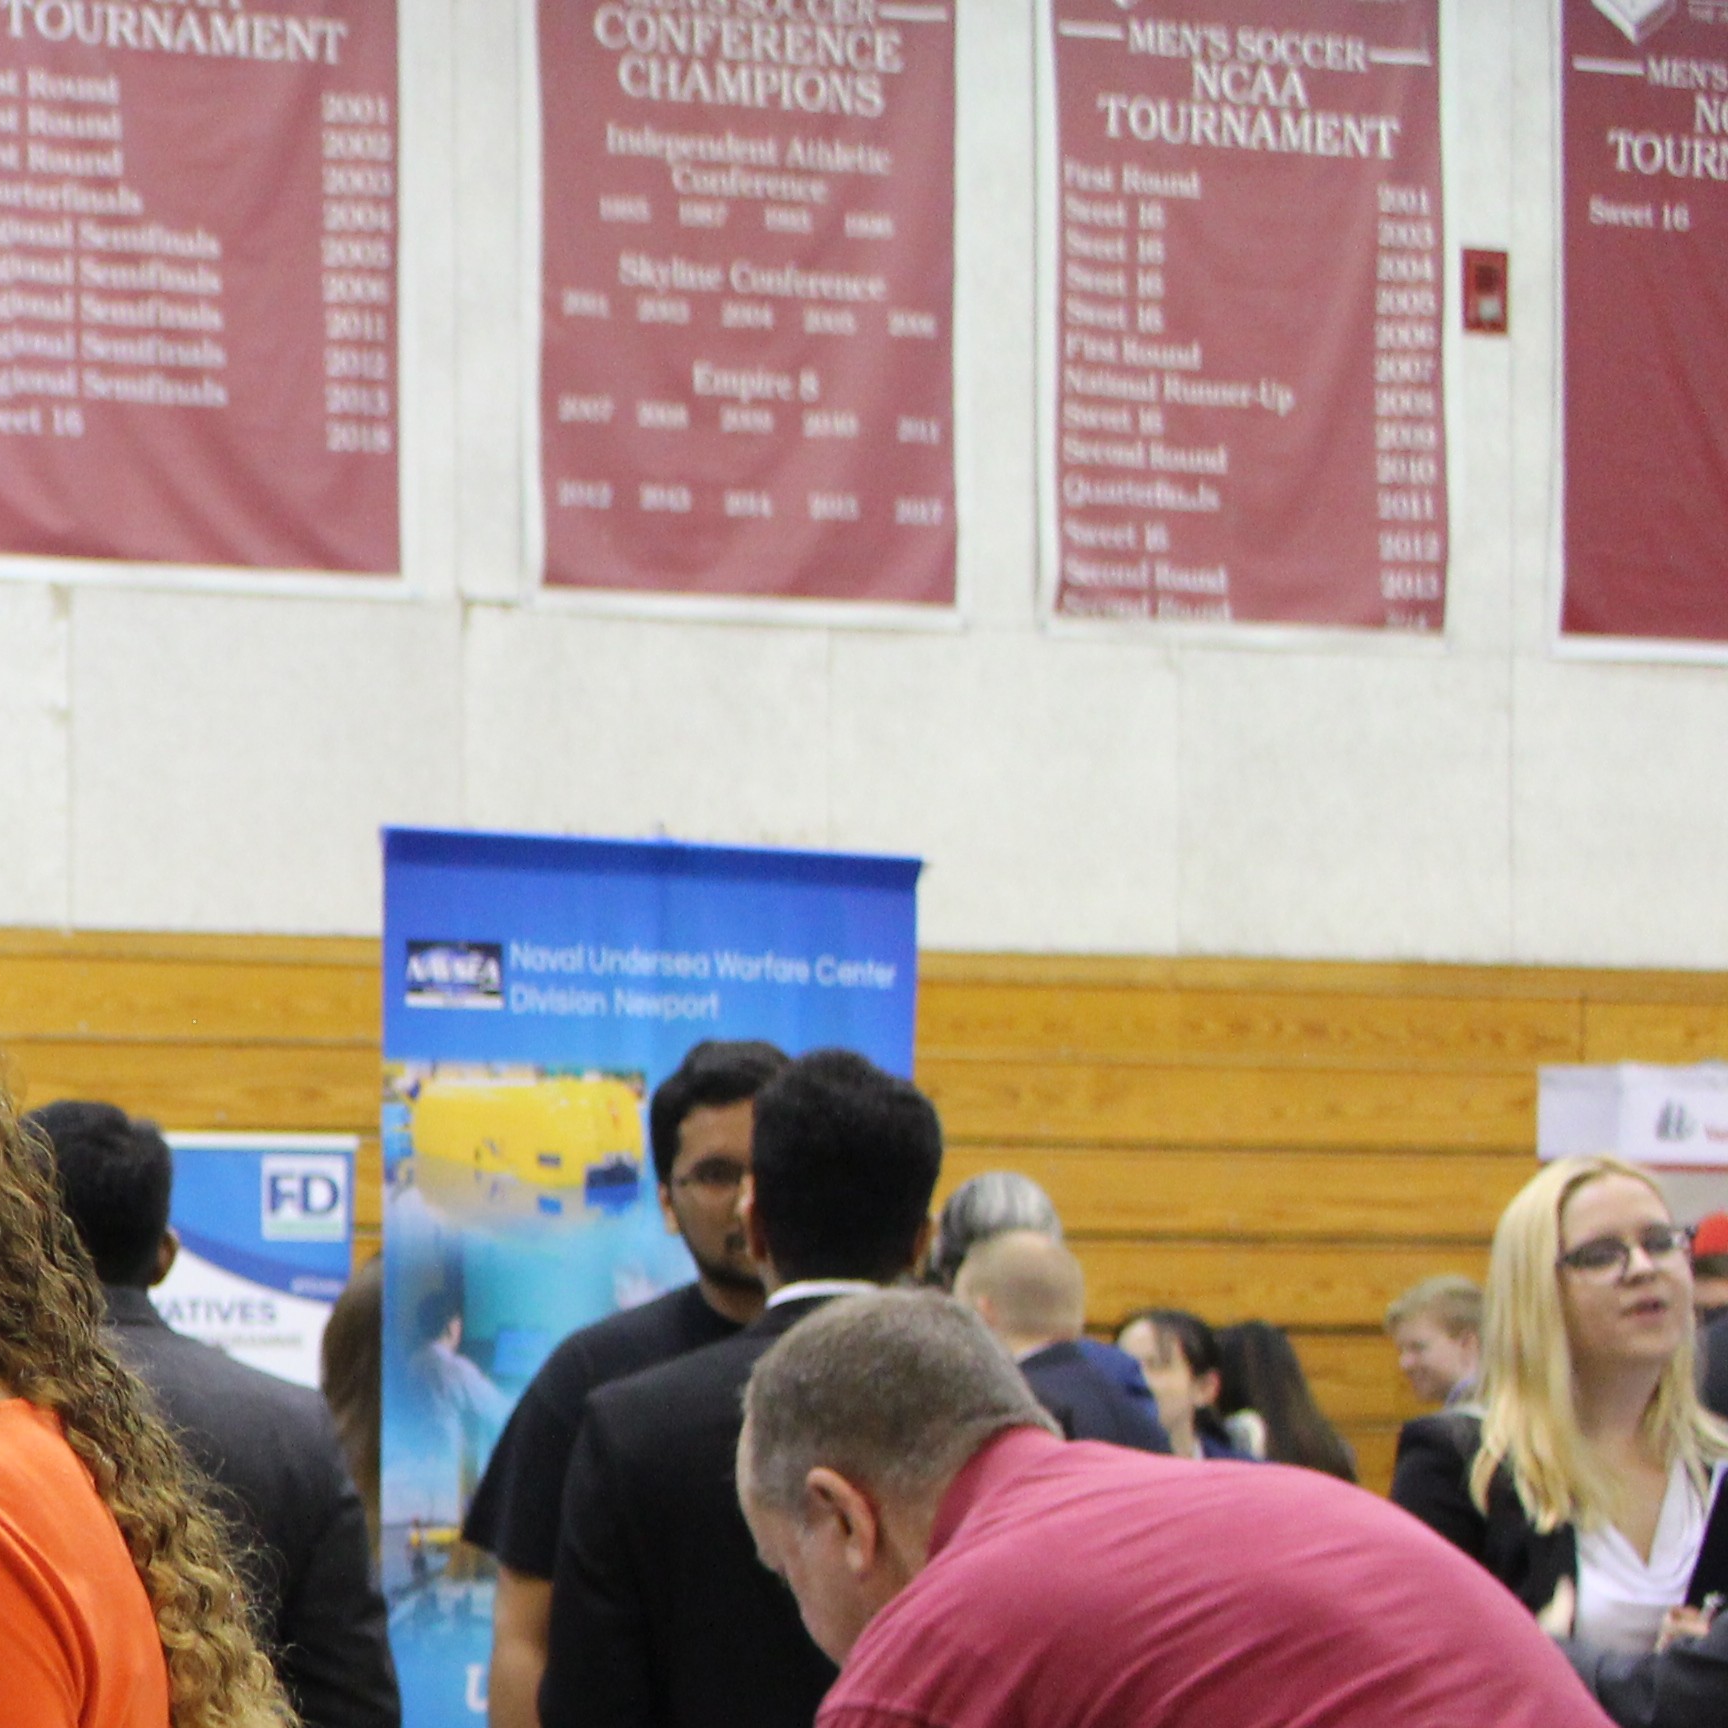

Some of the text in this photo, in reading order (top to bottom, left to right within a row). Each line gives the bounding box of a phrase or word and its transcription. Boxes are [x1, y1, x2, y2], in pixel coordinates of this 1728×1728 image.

[594, 2, 904, 74] CONFERENCE
[1128, 16, 1368, 74] MEN'S SOCCER
[28, 66, 120, 105] Round
[618, 52, 885, 118] CHAMPIONS
[1191, 59, 1309, 109] NCAA
[28, 103, 123, 140] Round
[1096, 92, 1401, 160] TOURNAMENT
[28, 140, 124, 177] Round
[606, 121, 893, 175] Independent Athletic
[672, 163, 828, 203] Conference
[1122, 163, 1201, 199] Round
[1065, 194, 1128, 230] Sweet
[1138, 200, 1166, 230] 16
[1589, 195, 1691, 233] Sweet 16
[1065, 226, 1128, 263] Sweet
[1137, 233, 1166, 265] 16
[619, 251, 887, 301] Skyline Conference
[1065, 258, 1128, 298] Sweet
[1137, 267, 1166, 300] 16
[1065, 294, 1128, 332] Sweet
[1136, 302, 1165, 334] 16
[1122, 334, 1203, 371] Round
[693, 358, 793, 403] Empire
[1064, 363, 1158, 401] National
[1163, 371, 1296, 418] Runner-Up
[52, 405, 85, 438] 16
[1063, 399, 1132, 434] Sweet
[1139, 404, 1165, 436] 16
[1063, 435, 1143, 468] Second
[1149, 440, 1228, 475] Round
[1155, 560, 1230, 595] Round
[509, 940, 899, 990] Naval Undersea Warfare Center
[510, 982, 609, 1017] Division
[613, 987, 719, 1022] Newport
[268, 1174, 340, 1215] FD
